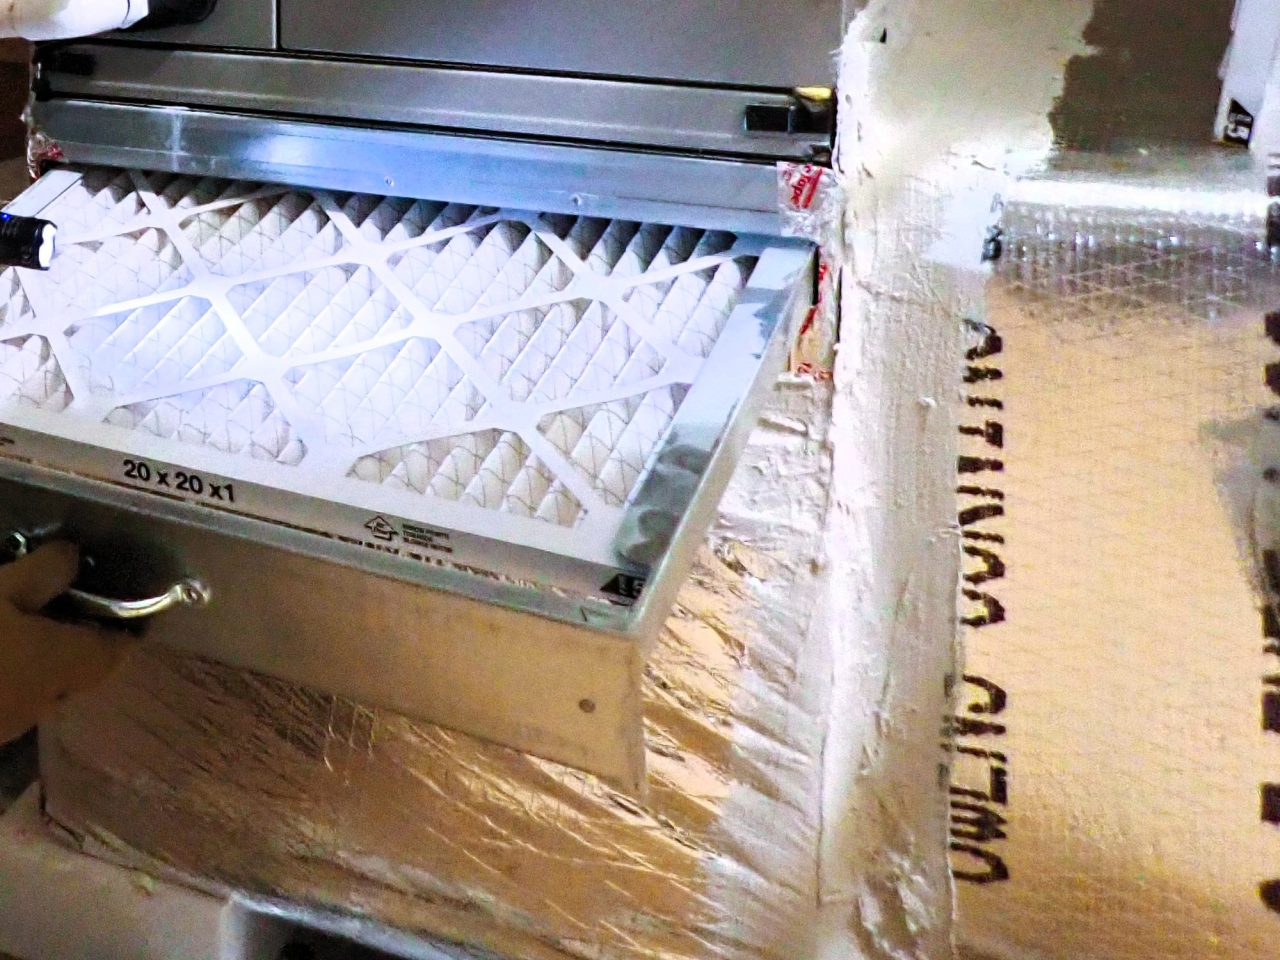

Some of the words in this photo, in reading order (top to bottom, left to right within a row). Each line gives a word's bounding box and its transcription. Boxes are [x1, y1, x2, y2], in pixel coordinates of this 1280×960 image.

[123, 459, 150, 481] 20
[156, 471, 169, 487] x
[175, 471, 203, 494] 20
